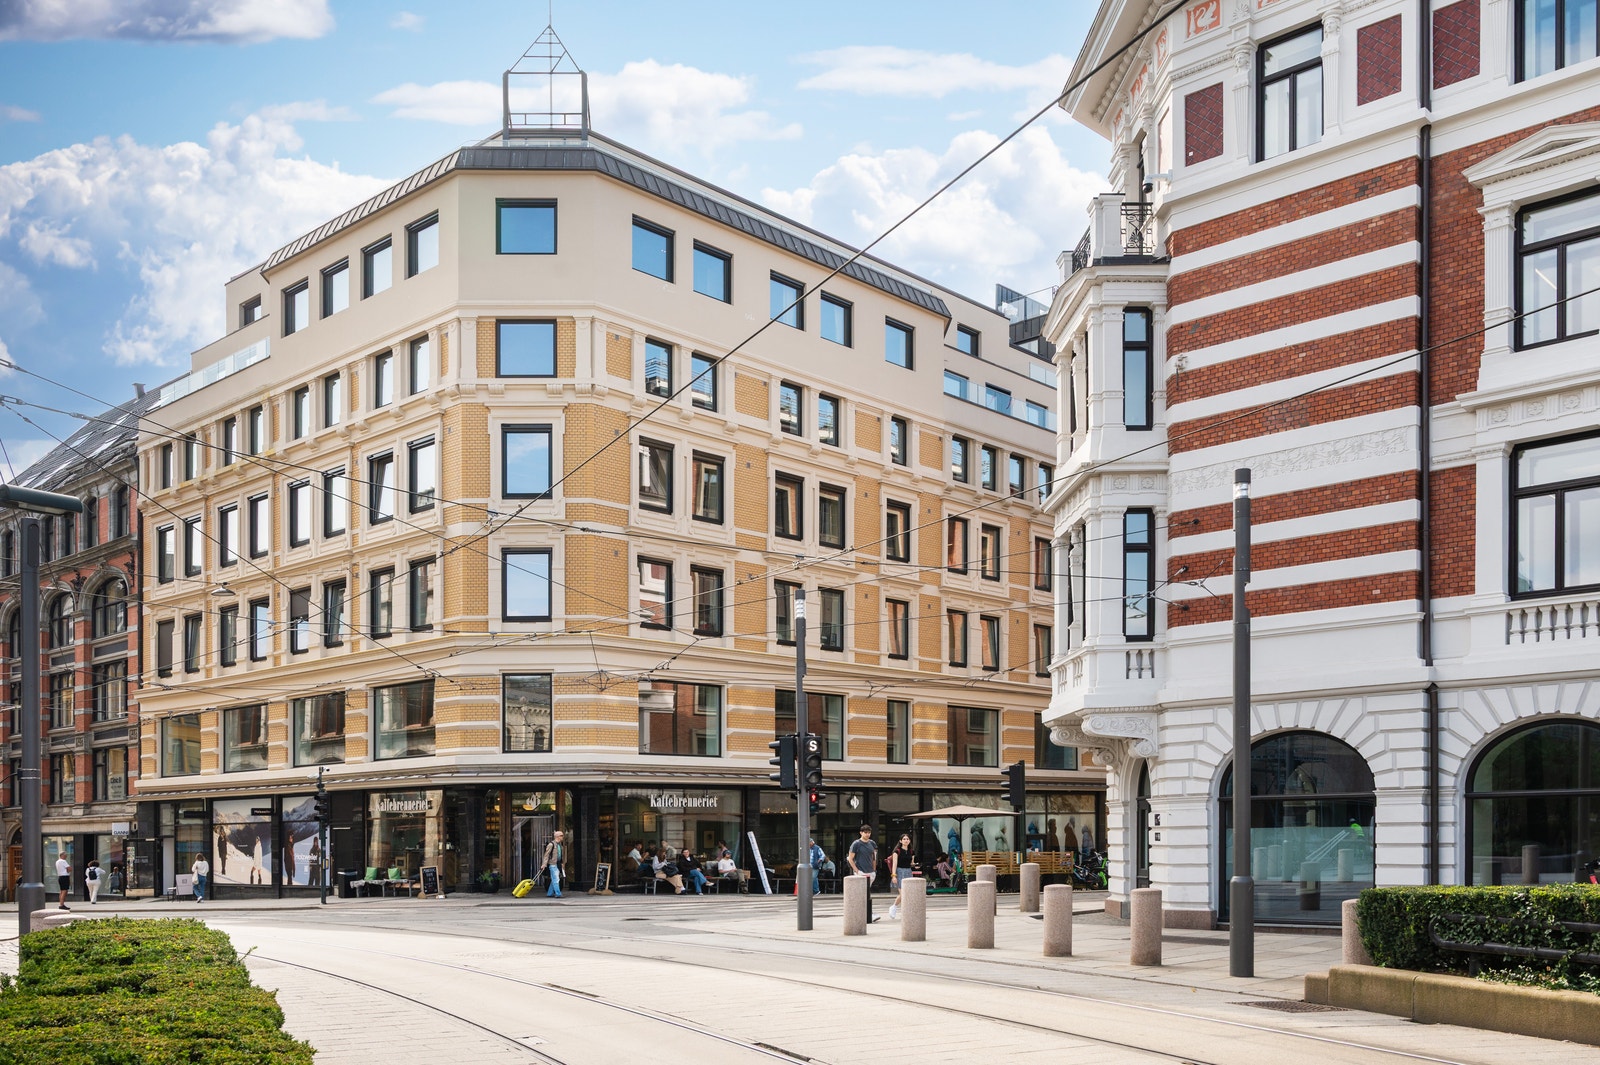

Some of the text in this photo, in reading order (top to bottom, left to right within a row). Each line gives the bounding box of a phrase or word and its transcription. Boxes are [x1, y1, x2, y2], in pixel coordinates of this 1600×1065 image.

[809, 740, 818, 752] S
[375, 798, 429, 811] Kaffebrenneriet
[650, 793, 718, 808] Kaffebrenneriet
